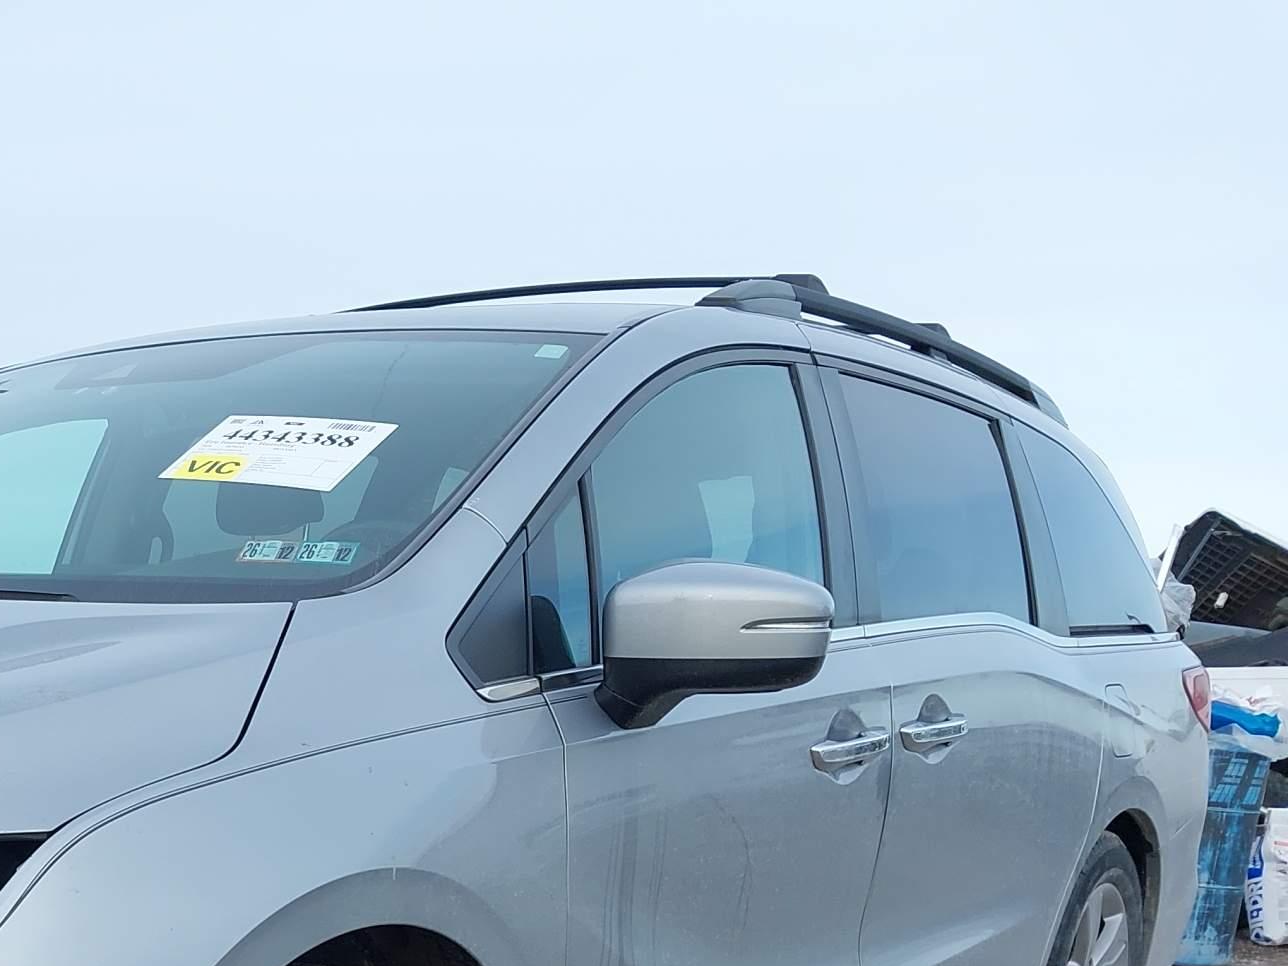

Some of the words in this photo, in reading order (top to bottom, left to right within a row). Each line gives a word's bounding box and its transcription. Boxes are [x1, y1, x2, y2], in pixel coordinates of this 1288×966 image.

[223, 428, 360, 449] 44343388
[187, 459, 241, 475] VIC
[242, 542, 261, 558] 26
[276, 545, 295, 560] 12
[299, 543, 318, 559] 26
[335, 547, 353, 562] 12
